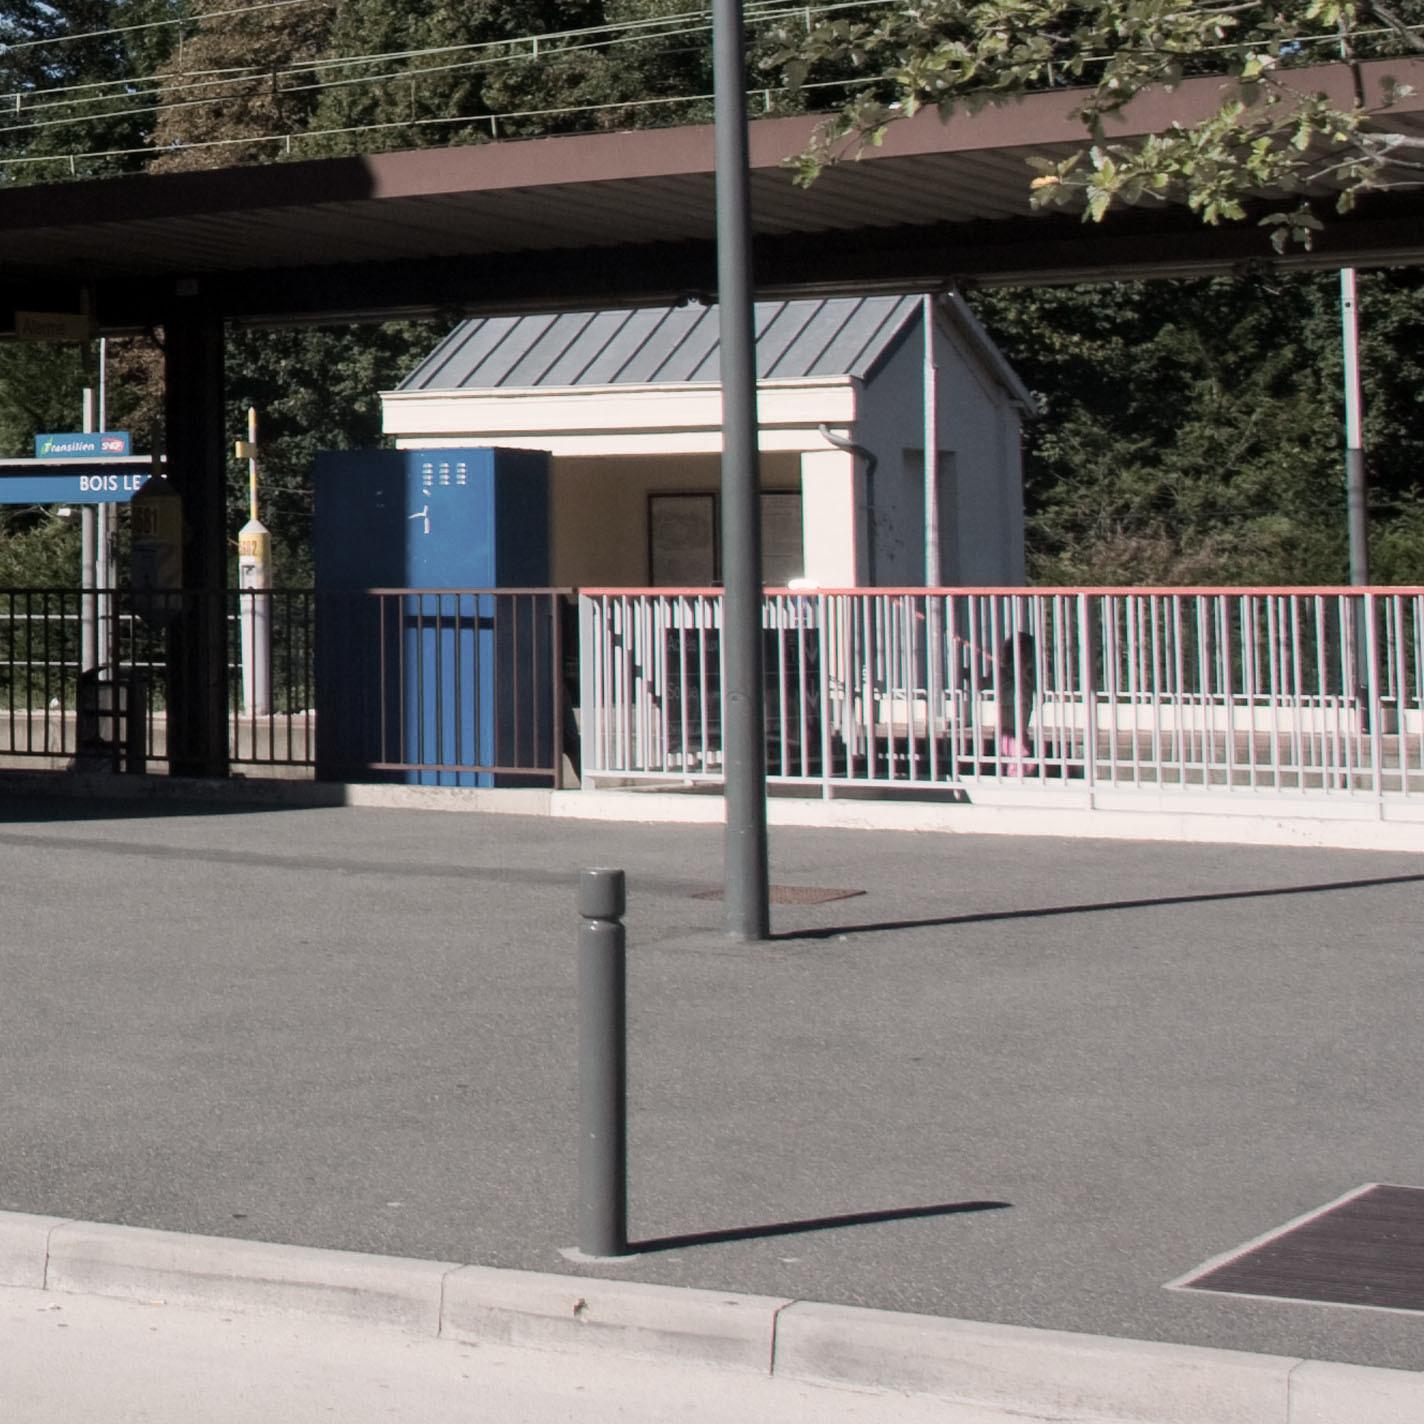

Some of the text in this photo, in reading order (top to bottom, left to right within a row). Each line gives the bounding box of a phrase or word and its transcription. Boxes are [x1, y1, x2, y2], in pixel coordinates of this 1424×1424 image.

[43, 441, 95, 453] Transilien
[79, 474, 142, 491] BOIS LE
